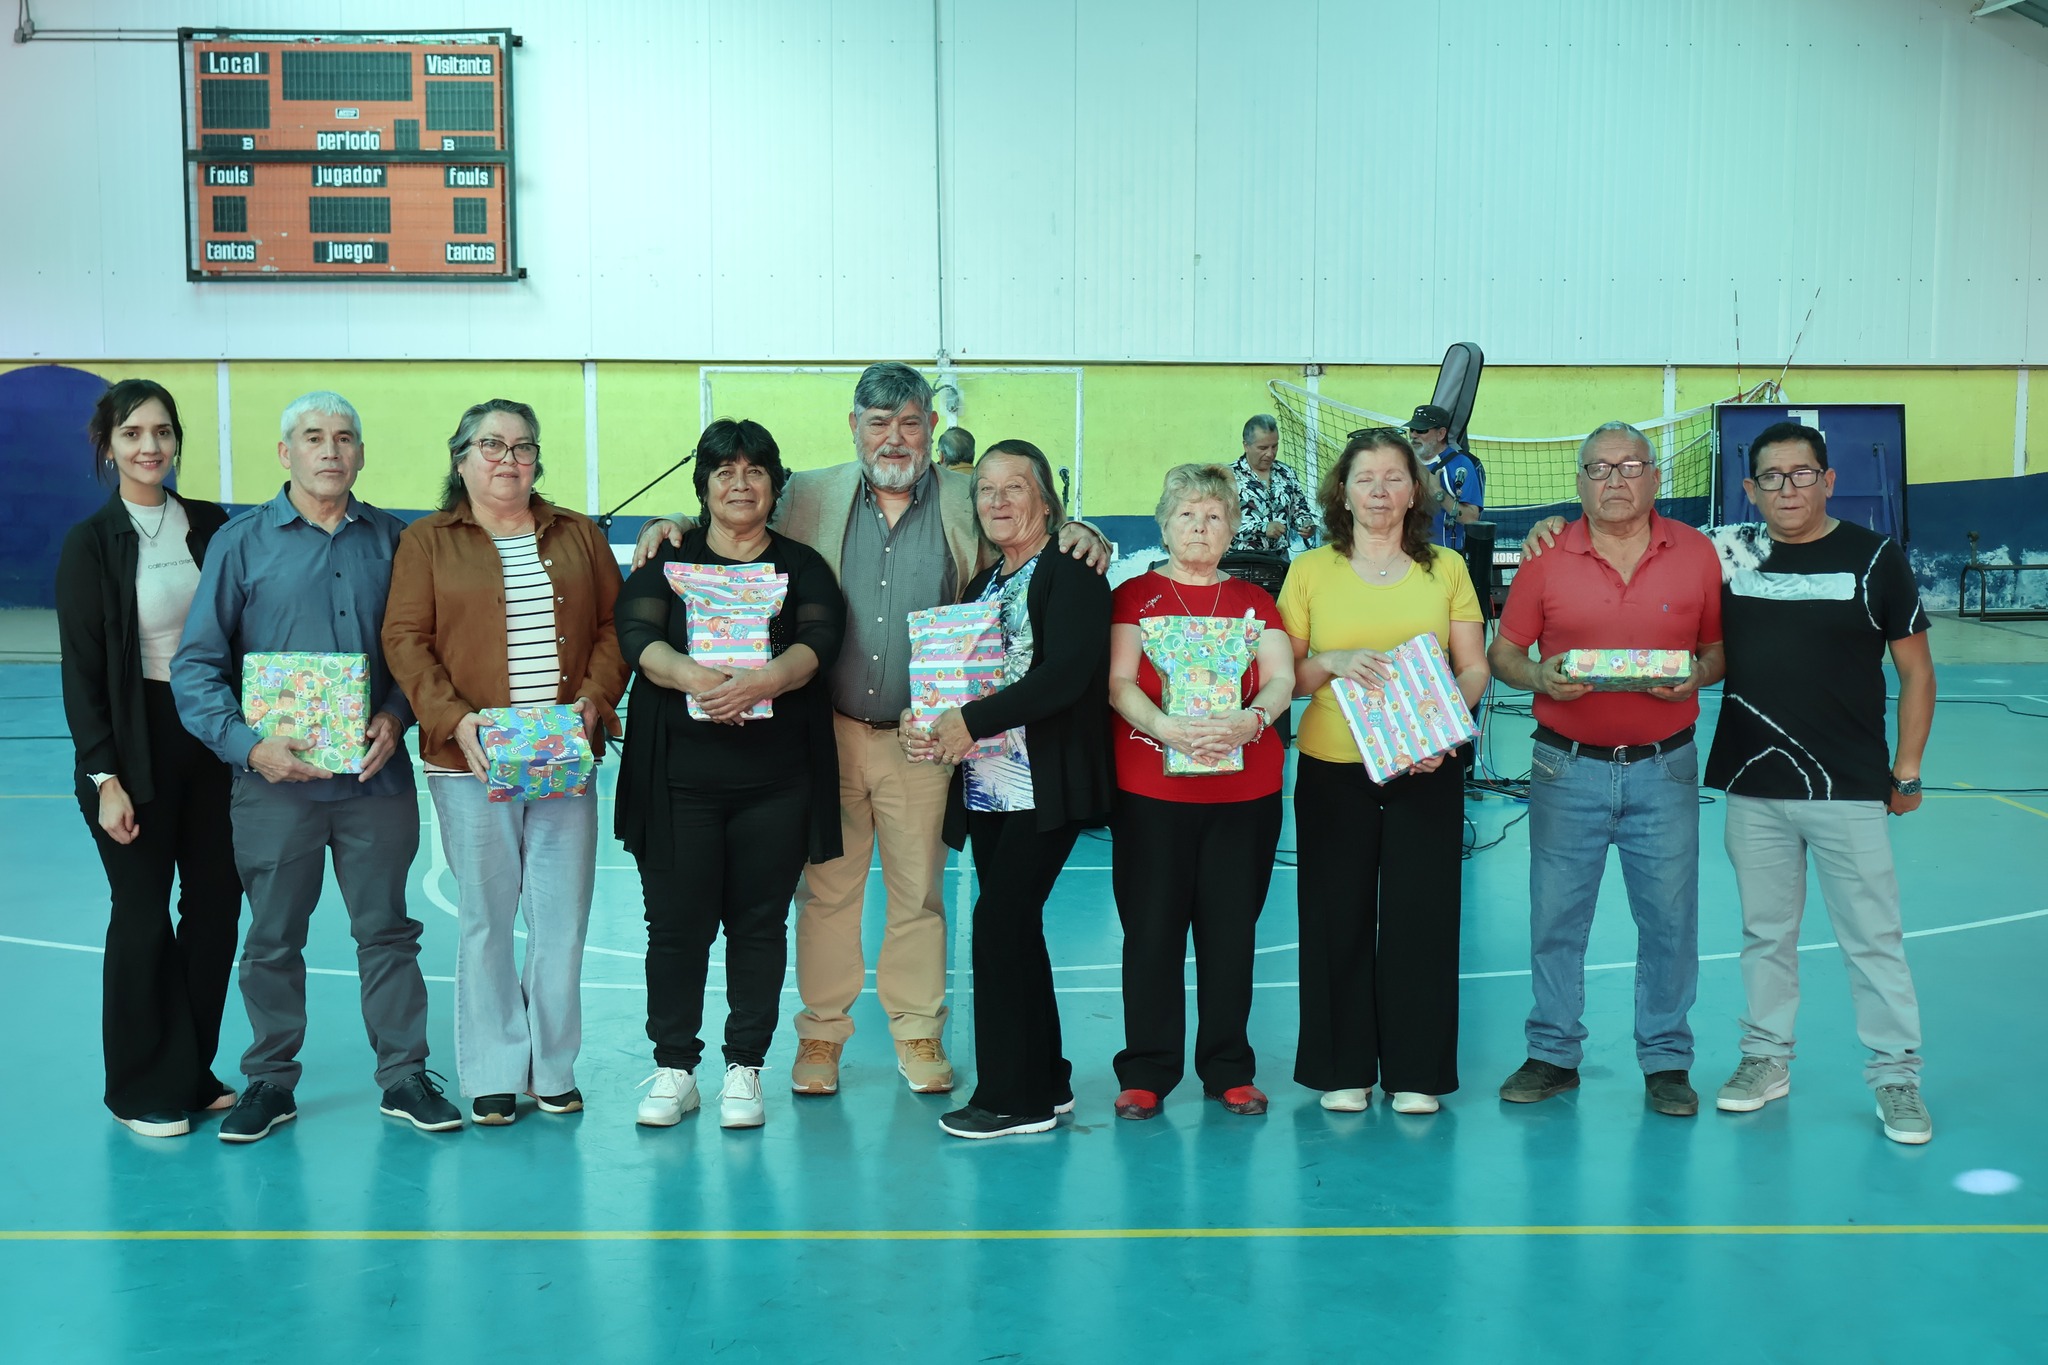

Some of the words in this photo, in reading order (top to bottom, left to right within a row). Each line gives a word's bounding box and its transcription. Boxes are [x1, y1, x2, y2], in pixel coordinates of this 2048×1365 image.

[209, 51, 260, 74] Local
[426, 54, 491, 75] Visitante
[242, 137, 254, 150] B
[317, 130, 380, 151] periodo
[443, 138, 455, 151] B
[209, 165, 249, 184] fouls
[316, 165, 382, 187] jugador
[449, 166, 489, 186] fouls
[206, 242, 255, 260] tantos
[326, 241, 374, 264] juego
[446, 243, 495, 261] tantos
[1493, 552, 1521, 563] KORG
